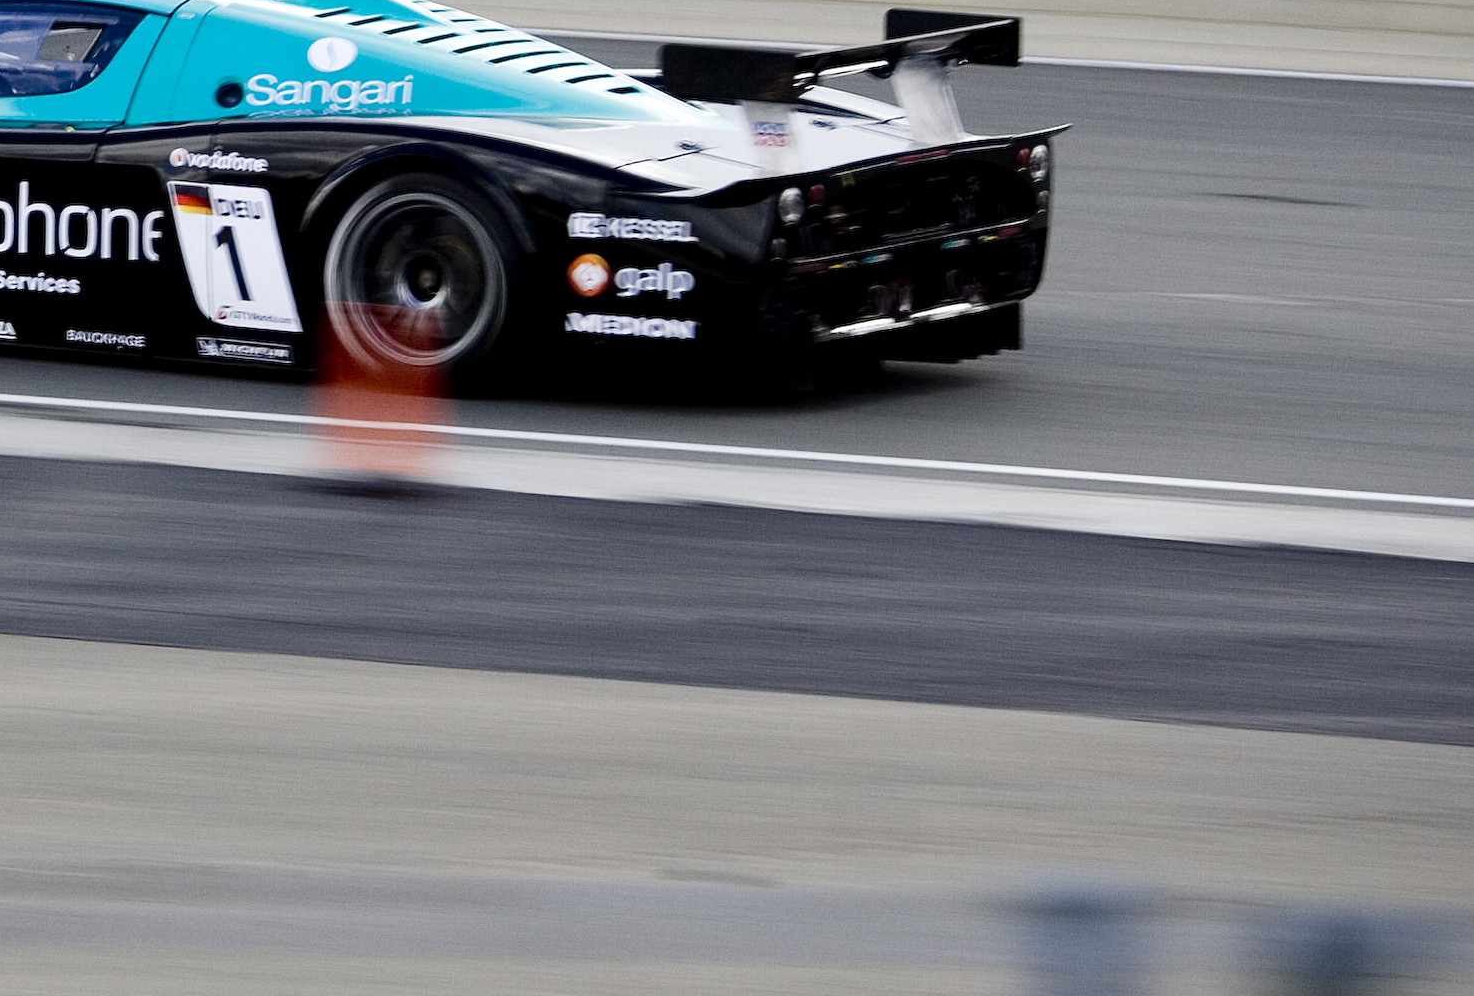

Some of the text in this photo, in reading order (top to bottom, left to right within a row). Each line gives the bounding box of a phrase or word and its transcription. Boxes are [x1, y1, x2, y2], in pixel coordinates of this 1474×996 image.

[245, 73, 414, 111] Sangari
[187, 150, 269, 172] vodafone
[607, 217, 699, 242] KESSEL
[212, 225, 253, 302] 1
[614, 262, 696, 299] galp
[565, 312, 696, 339] MEDION
